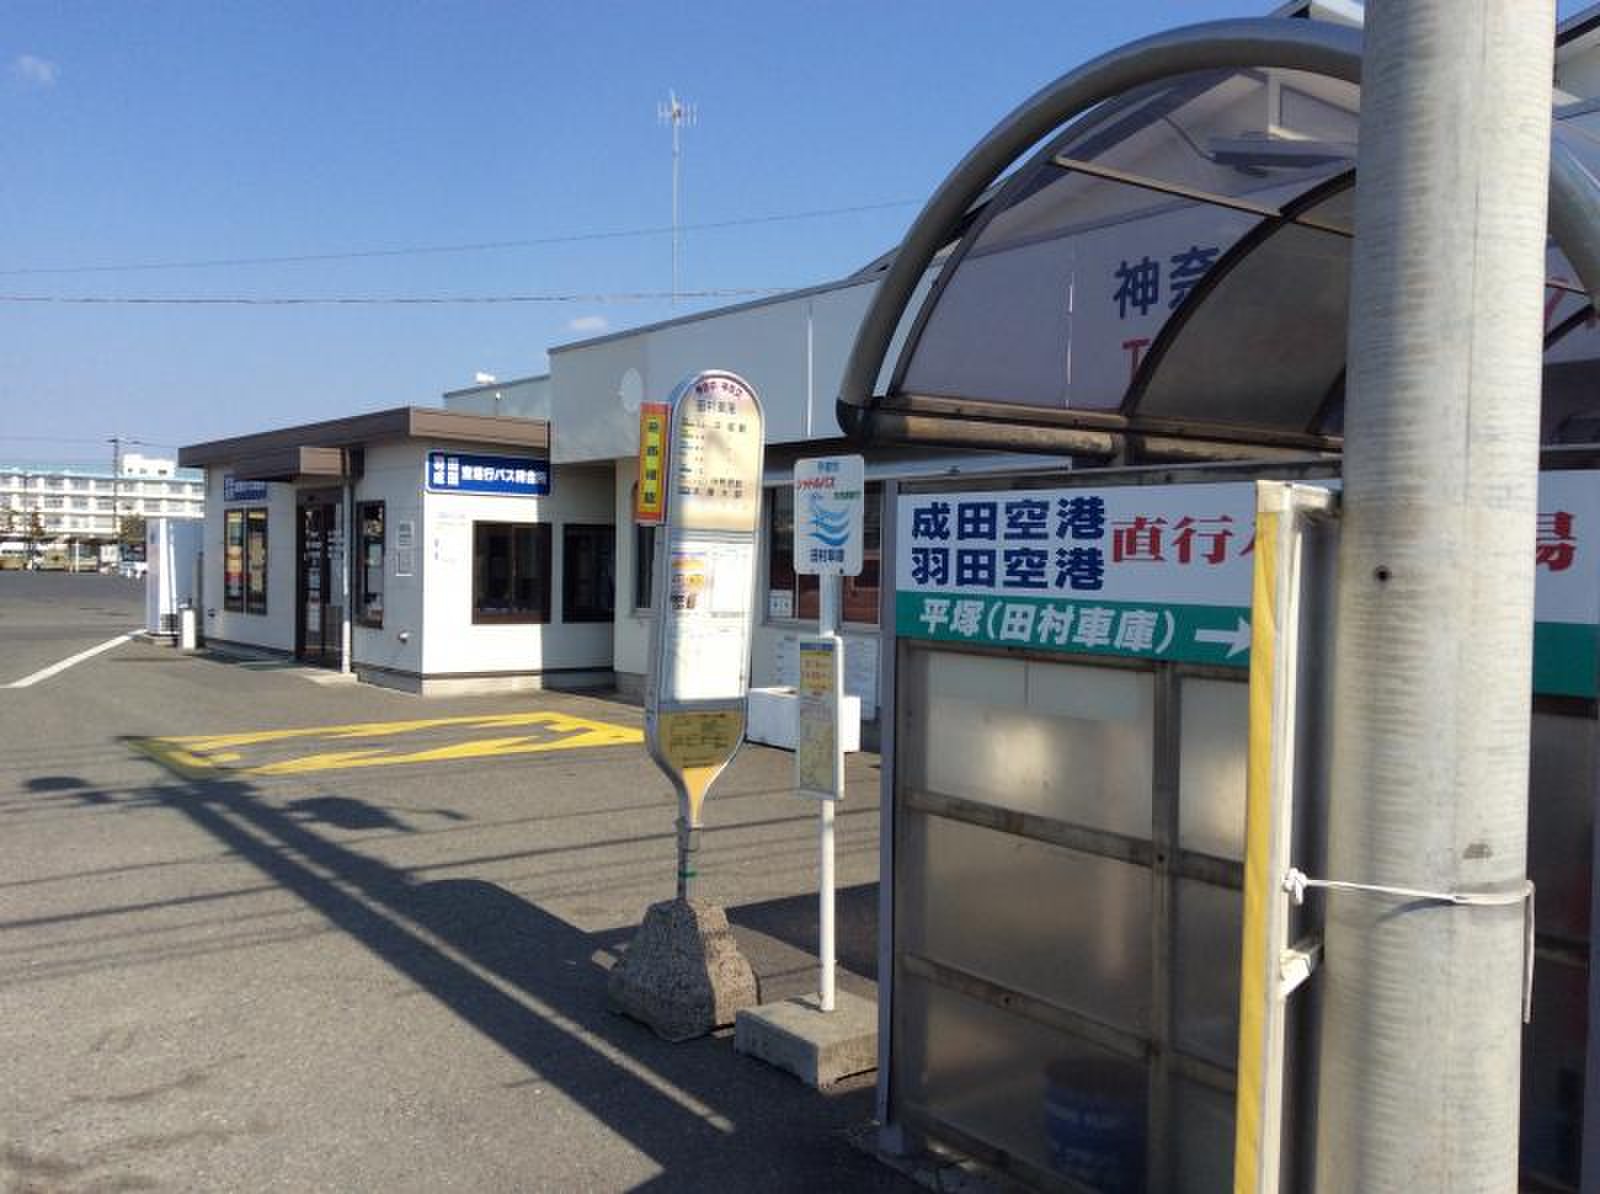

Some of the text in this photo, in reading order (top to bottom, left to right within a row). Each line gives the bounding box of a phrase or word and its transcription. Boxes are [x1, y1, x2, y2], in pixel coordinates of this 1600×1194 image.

[911, 496, 1105, 542] 成田空港
[1111, 514, 1257, 565] 直行
[911, 546, 1105, 592] 羽田空港
[919, 598, 1176, 654] 平塚(田村車庫)
